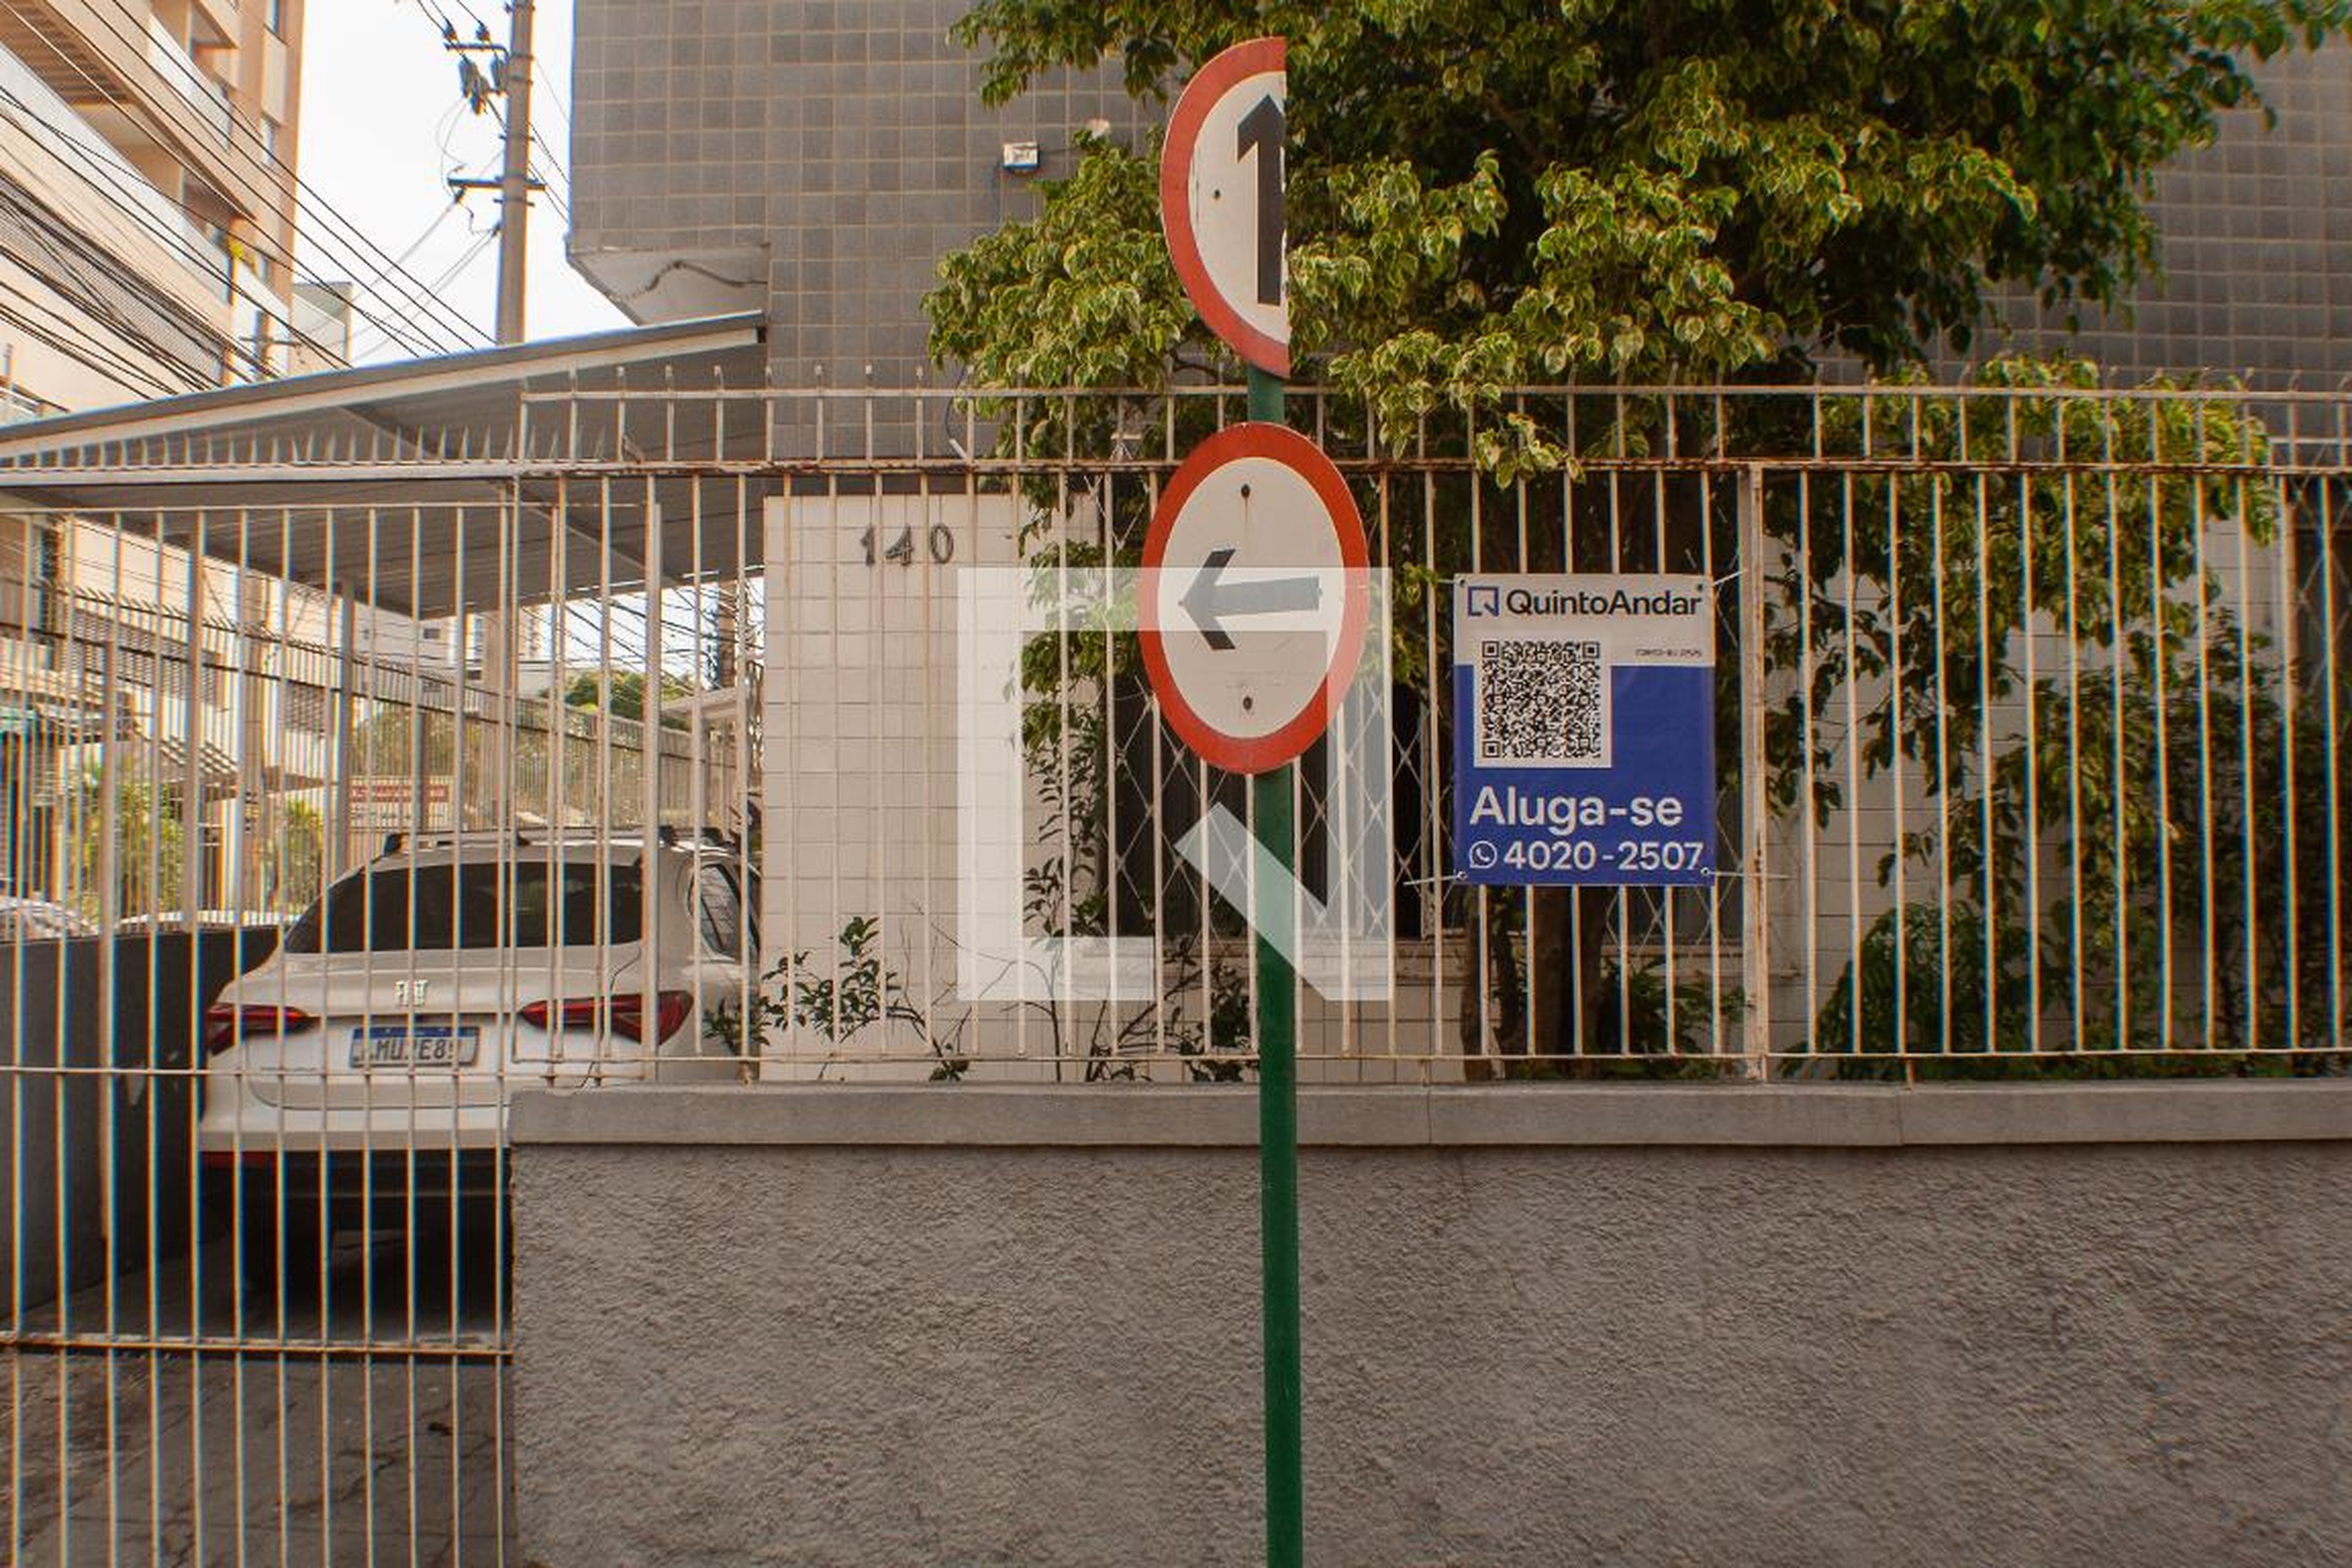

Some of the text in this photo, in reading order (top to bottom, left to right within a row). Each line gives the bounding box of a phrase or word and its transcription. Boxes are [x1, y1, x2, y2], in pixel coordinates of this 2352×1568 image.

[861, 523, 954, 567] 140
[1506, 589, 1702, 616] QuintoAndar
[1470, 785, 1683, 836] Aluga-se
[1503, 840, 1704, 870] 4020-2507
[361, 1039, 459, 1061] MUE8
